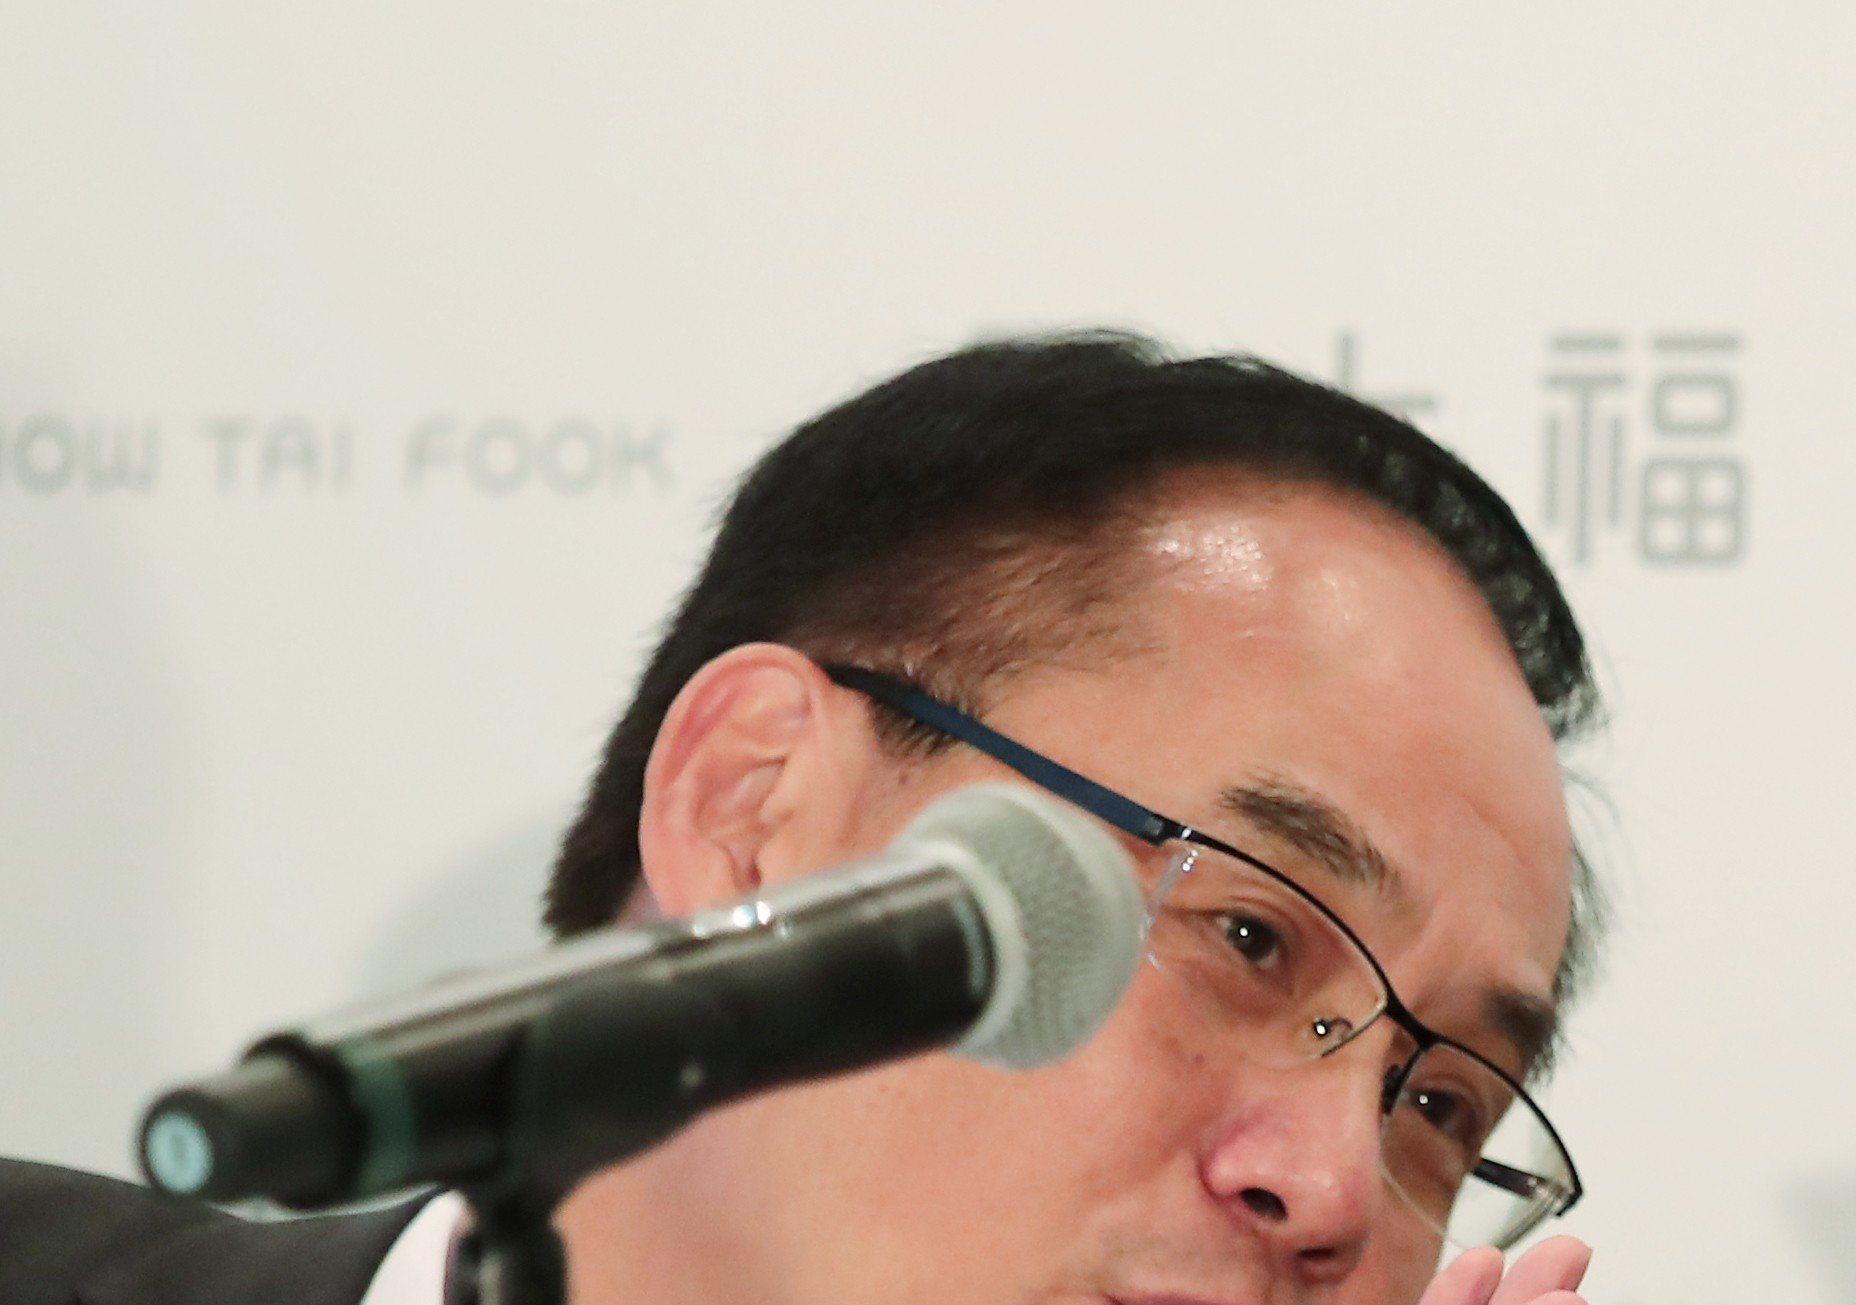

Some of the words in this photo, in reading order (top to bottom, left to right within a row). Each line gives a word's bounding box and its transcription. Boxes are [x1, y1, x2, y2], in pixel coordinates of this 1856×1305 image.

[0, 413, 162, 497] OW
[200, 414, 356, 492] TAI
[405, 413, 678, 497] FOOK
